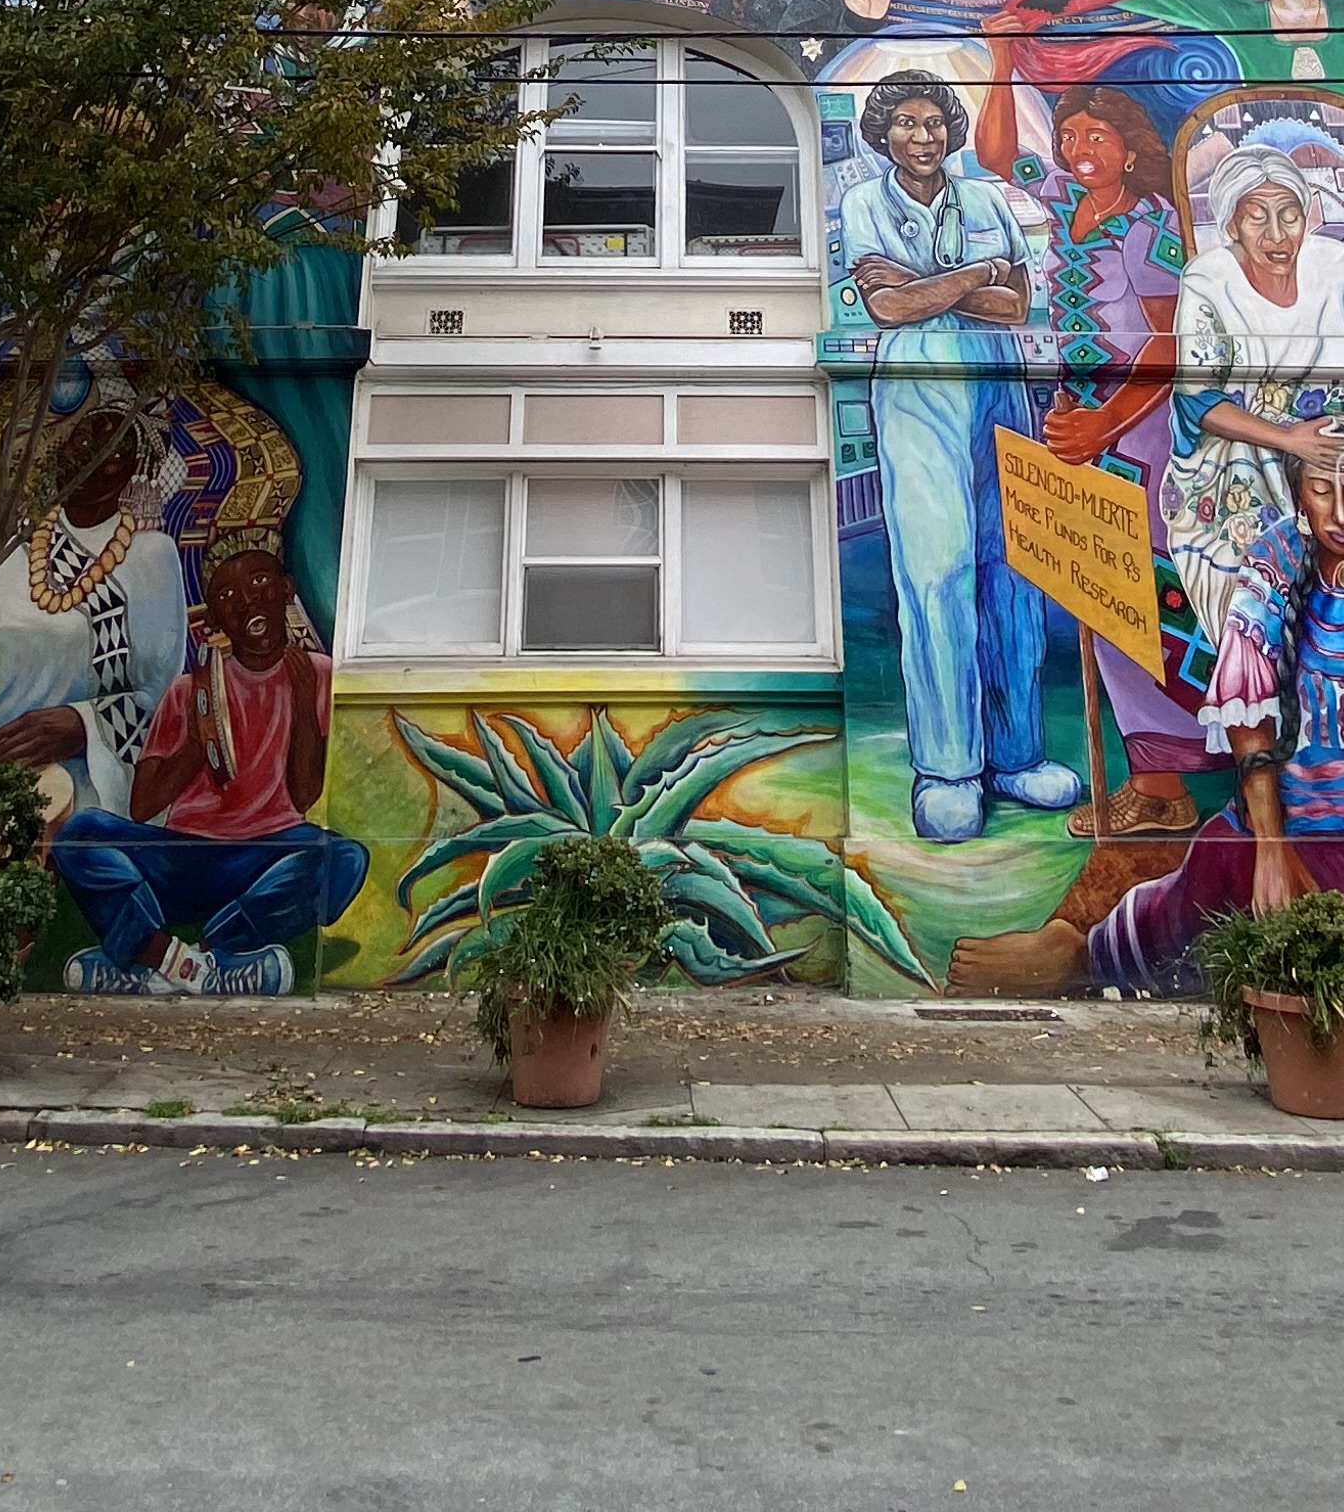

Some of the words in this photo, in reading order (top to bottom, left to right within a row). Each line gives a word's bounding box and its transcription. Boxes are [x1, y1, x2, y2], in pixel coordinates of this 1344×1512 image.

[1005, 485, 1042, 525] MORE
[1044, 506, 1088, 551] FUNDS
[1092, 534, 1118, 570] FOR
[1008, 520, 1062, 575] HEALTH
[1070, 559, 1148, 634] RESEARCH
